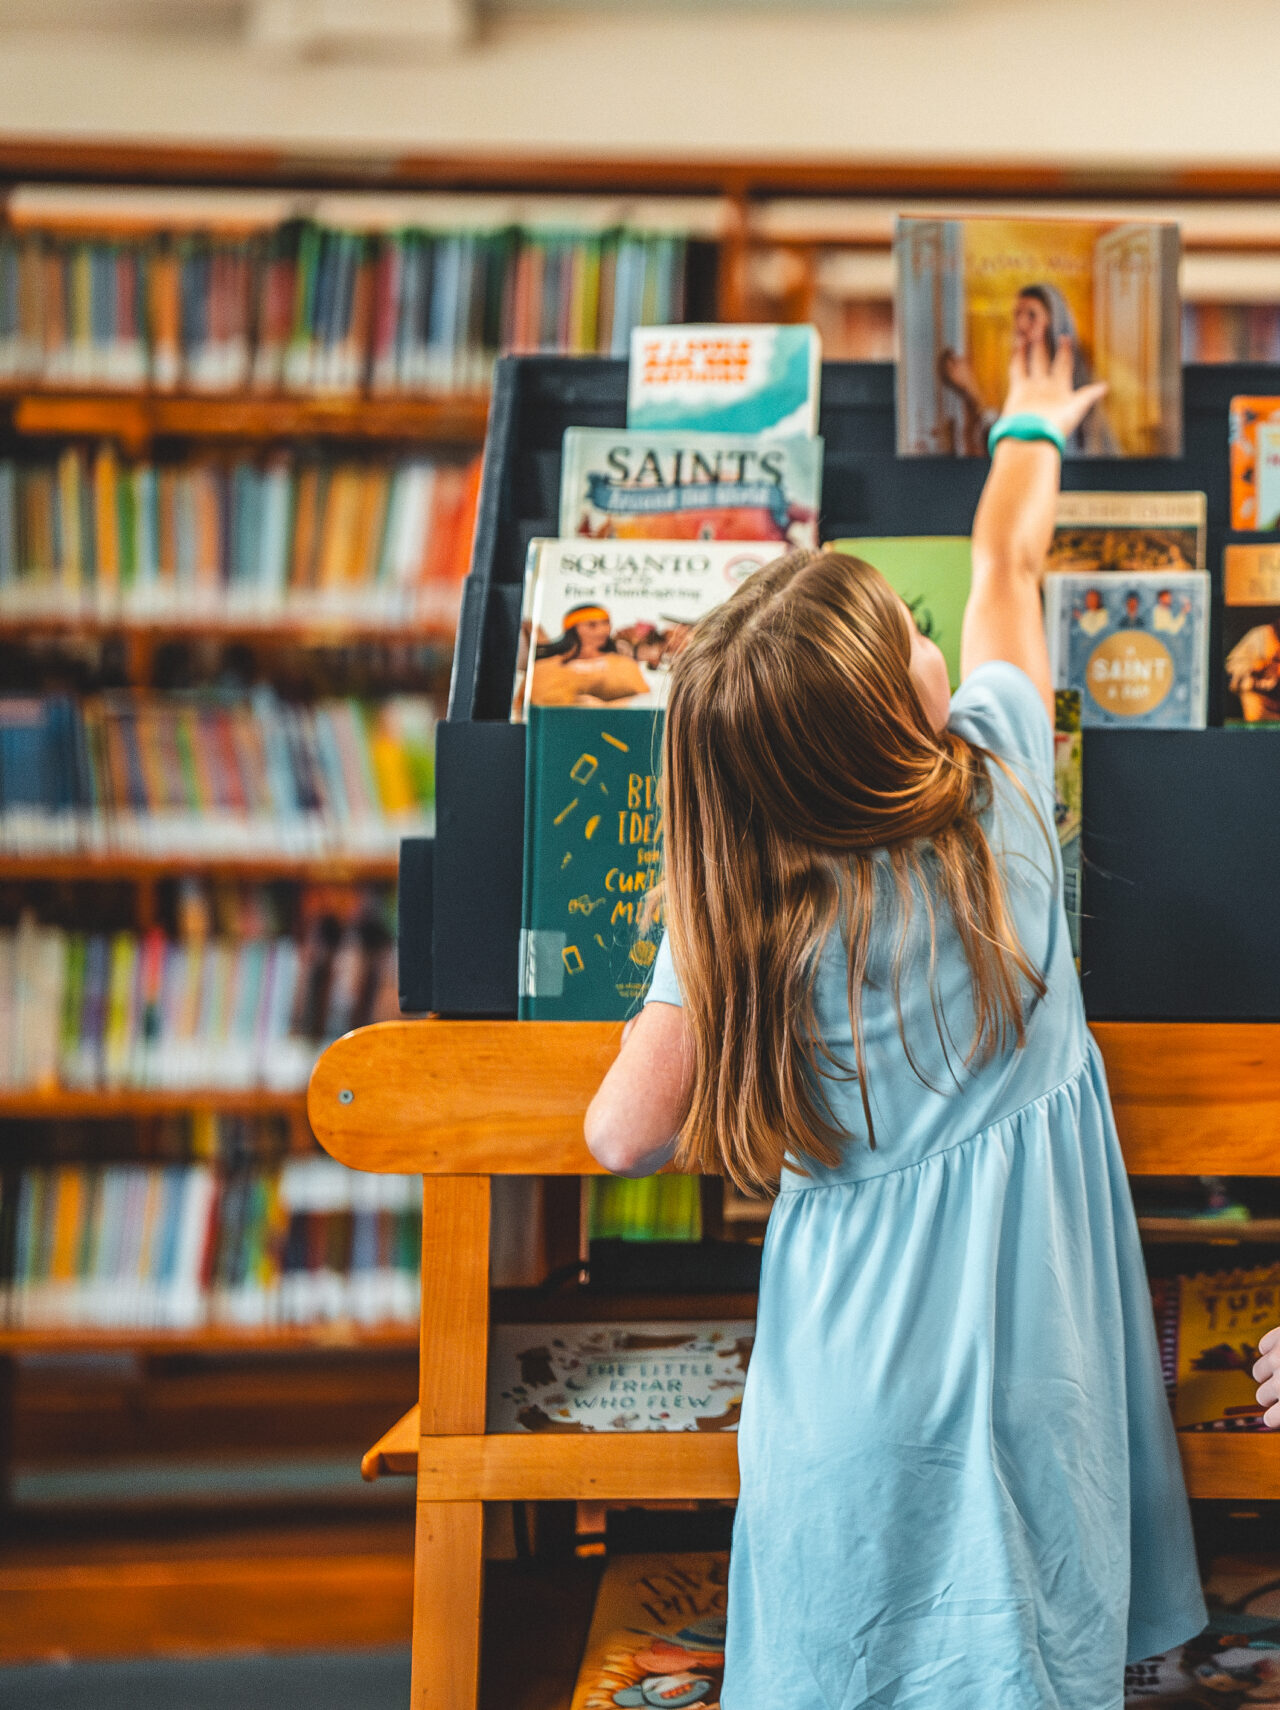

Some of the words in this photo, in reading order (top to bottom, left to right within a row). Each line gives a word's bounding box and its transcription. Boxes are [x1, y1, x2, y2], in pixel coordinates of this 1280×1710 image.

[607, 446, 785, 487] SAINTS
[560, 553, 711, 577] SQUANTO
[1092, 658, 1170, 682] SAINT
[573, 1396, 637, 1409] WHO
